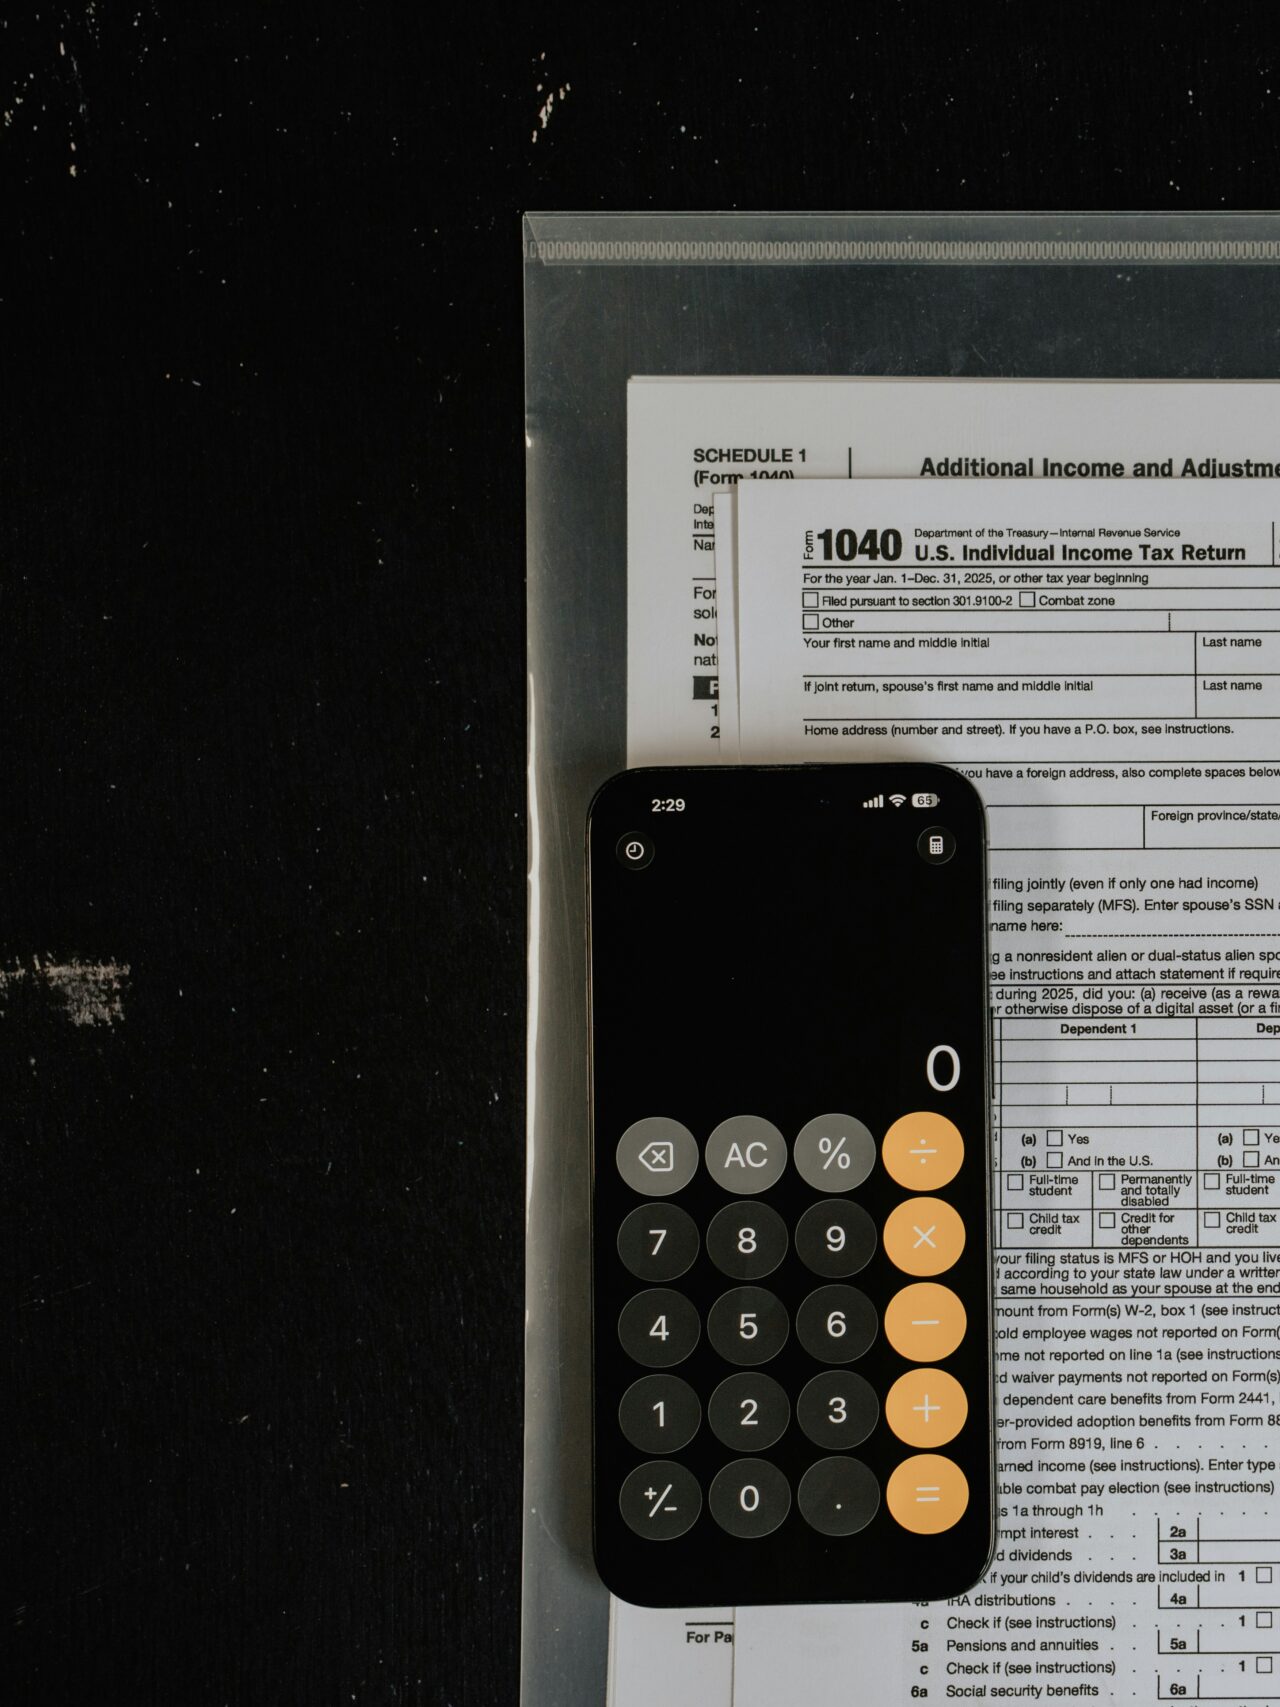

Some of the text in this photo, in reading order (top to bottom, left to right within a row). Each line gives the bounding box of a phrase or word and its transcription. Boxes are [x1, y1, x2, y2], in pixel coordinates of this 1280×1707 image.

[693, 448, 806, 463] SCHEDULE 1
[920, 457, 1034, 477] Additional
[1043, 458, 1125, 477] Income
[1132, 458, 1173, 477] and
[914, 528, 972, 539] Department
[975, 528, 985, 538] of
[988, 528, 1004, 538] the
[1098, 528, 1141, 538] Revenue
[1144, 528, 1181, 537] Service
[803, 530, 814, 560] Form
[817, 528, 902, 561] 1040
[915, 544, 1246, 561] U.S. Individual Income Tax Return
[822, 595, 1012, 609] Filed pursuant to section 301.9100-2
[1039, 595, 1115, 606] Combat zone
[822, 617, 854, 628] Other
[803, 637, 989, 648] Your first name and middle initial
[1203, 637, 1262, 647] Last name
[652, 798, 685, 812] 2:29
[917, 793, 934, 807] 65
[1060, 1023, 1136, 1036] Dependent 1
[927, 1045, 960, 1092] 0
[724, 1142, 767, 1168] AC
[1029, 1174, 1078, 1185] Full-time
[1029, 1185, 1072, 1196] student
[1226, 1212, 1276, 1223] Child tax
[1226, 1222, 1258, 1234] credit
[649, 1229, 667, 1255] 7
[738, 1227, 757, 1253] 8
[826, 1226, 845, 1252] 9
[649, 1315, 669, 1341] 4
[740, 1313, 758, 1339] 5
[827, 1311, 846, 1337] 6
[653, 1401, 664, 1427] 1
[740, 1399, 758, 1425] 2
[829, 1397, 847, 1423] 3
[740, 1485, 759, 1512] 0
[1170, 1526, 1186, 1538] 2a
[1170, 1548, 1186, 1560] 3a
[1170, 1593, 1187, 1605] 4a
[686, 1631, 709, 1643] For
[1170, 1638, 1187, 1650] 5a
[912, 1638, 1099, 1652] 5a Pensions and annuities
[911, 1683, 1099, 1699] 6a Social security benefits
[1170, 1683, 1186, 1698] 6a
